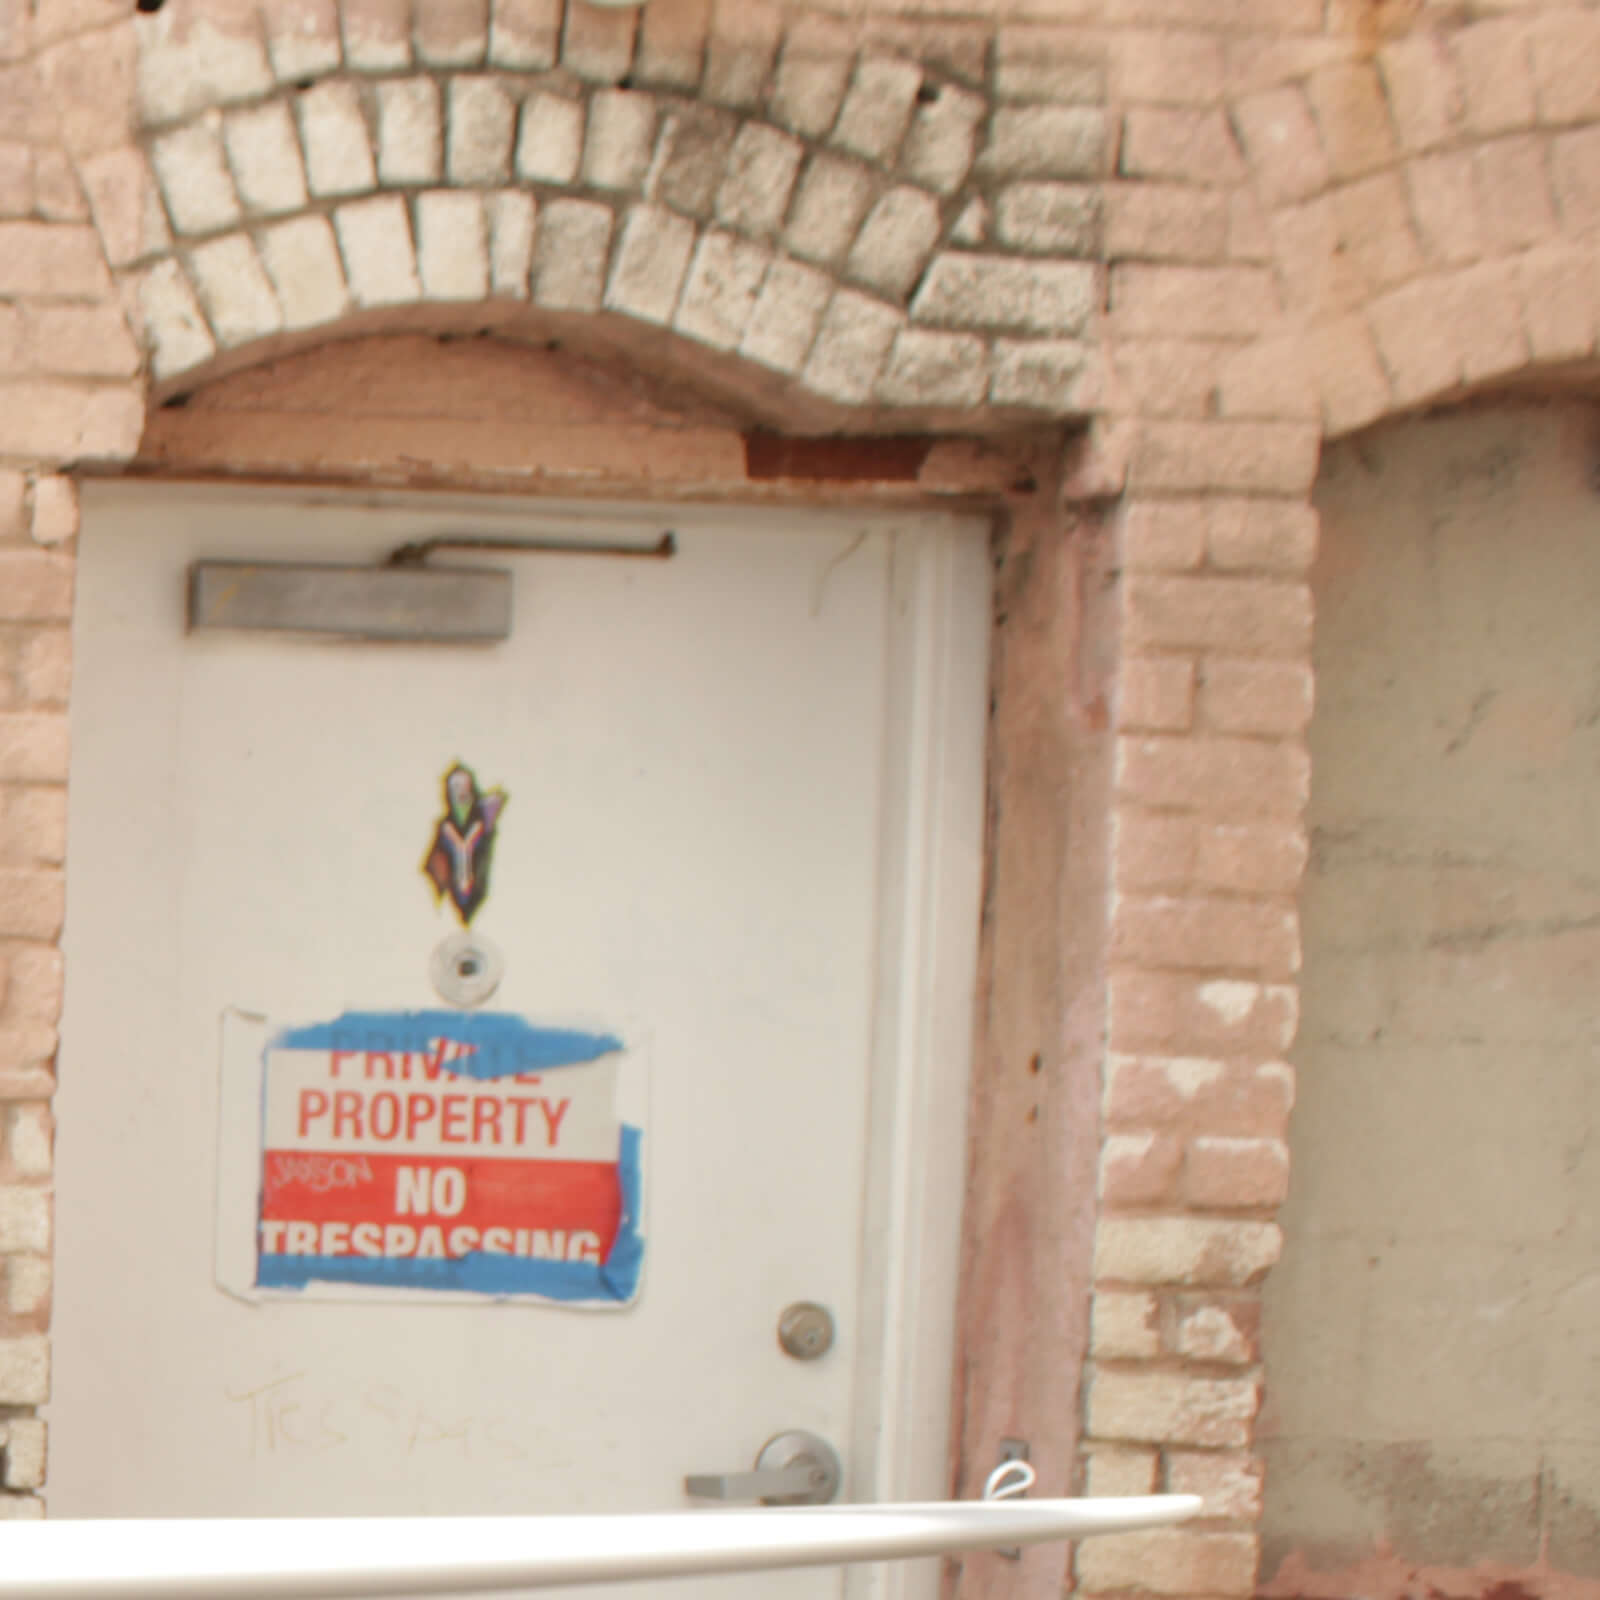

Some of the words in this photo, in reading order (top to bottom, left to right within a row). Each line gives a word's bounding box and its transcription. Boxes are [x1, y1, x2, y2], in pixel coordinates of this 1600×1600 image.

[329, 1030, 542, 1085] PRIVAE
[297, 1088, 571, 1147] PROPERTY
[395, 1166, 466, 1216] NO
[257, 1219, 602, 1267] TRESPASSING
